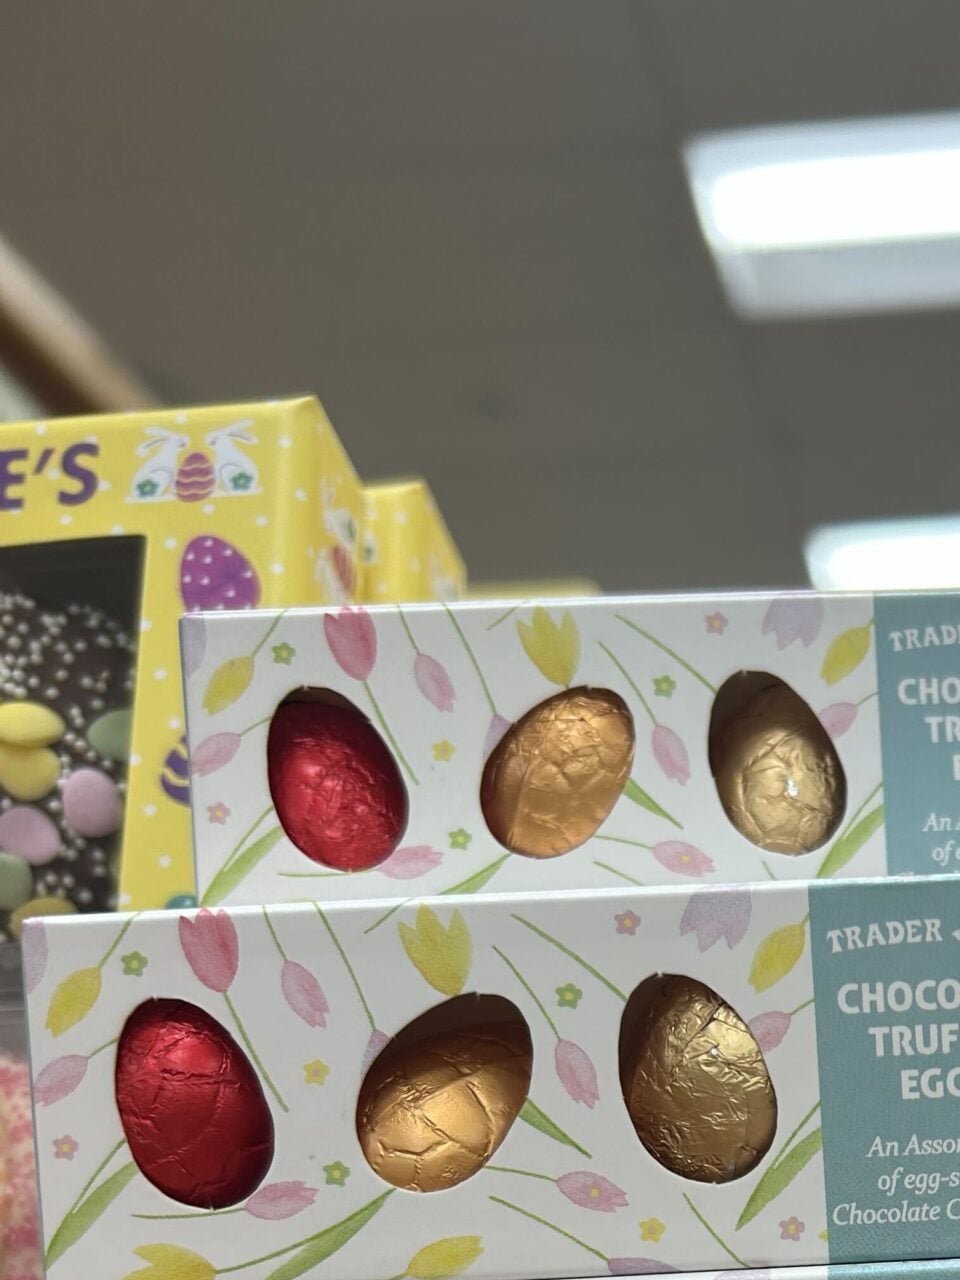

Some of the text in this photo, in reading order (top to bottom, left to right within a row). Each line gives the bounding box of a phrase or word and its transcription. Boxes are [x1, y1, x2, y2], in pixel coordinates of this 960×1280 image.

[923, 813, 951, 831] An
[932, 839, 954, 866] of
[826, 919, 942, 953] TRADER
[865, 1136, 899, 1157] An
[877, 1169, 902, 1195] of
[832, 1203, 940, 1226] Chocolate
